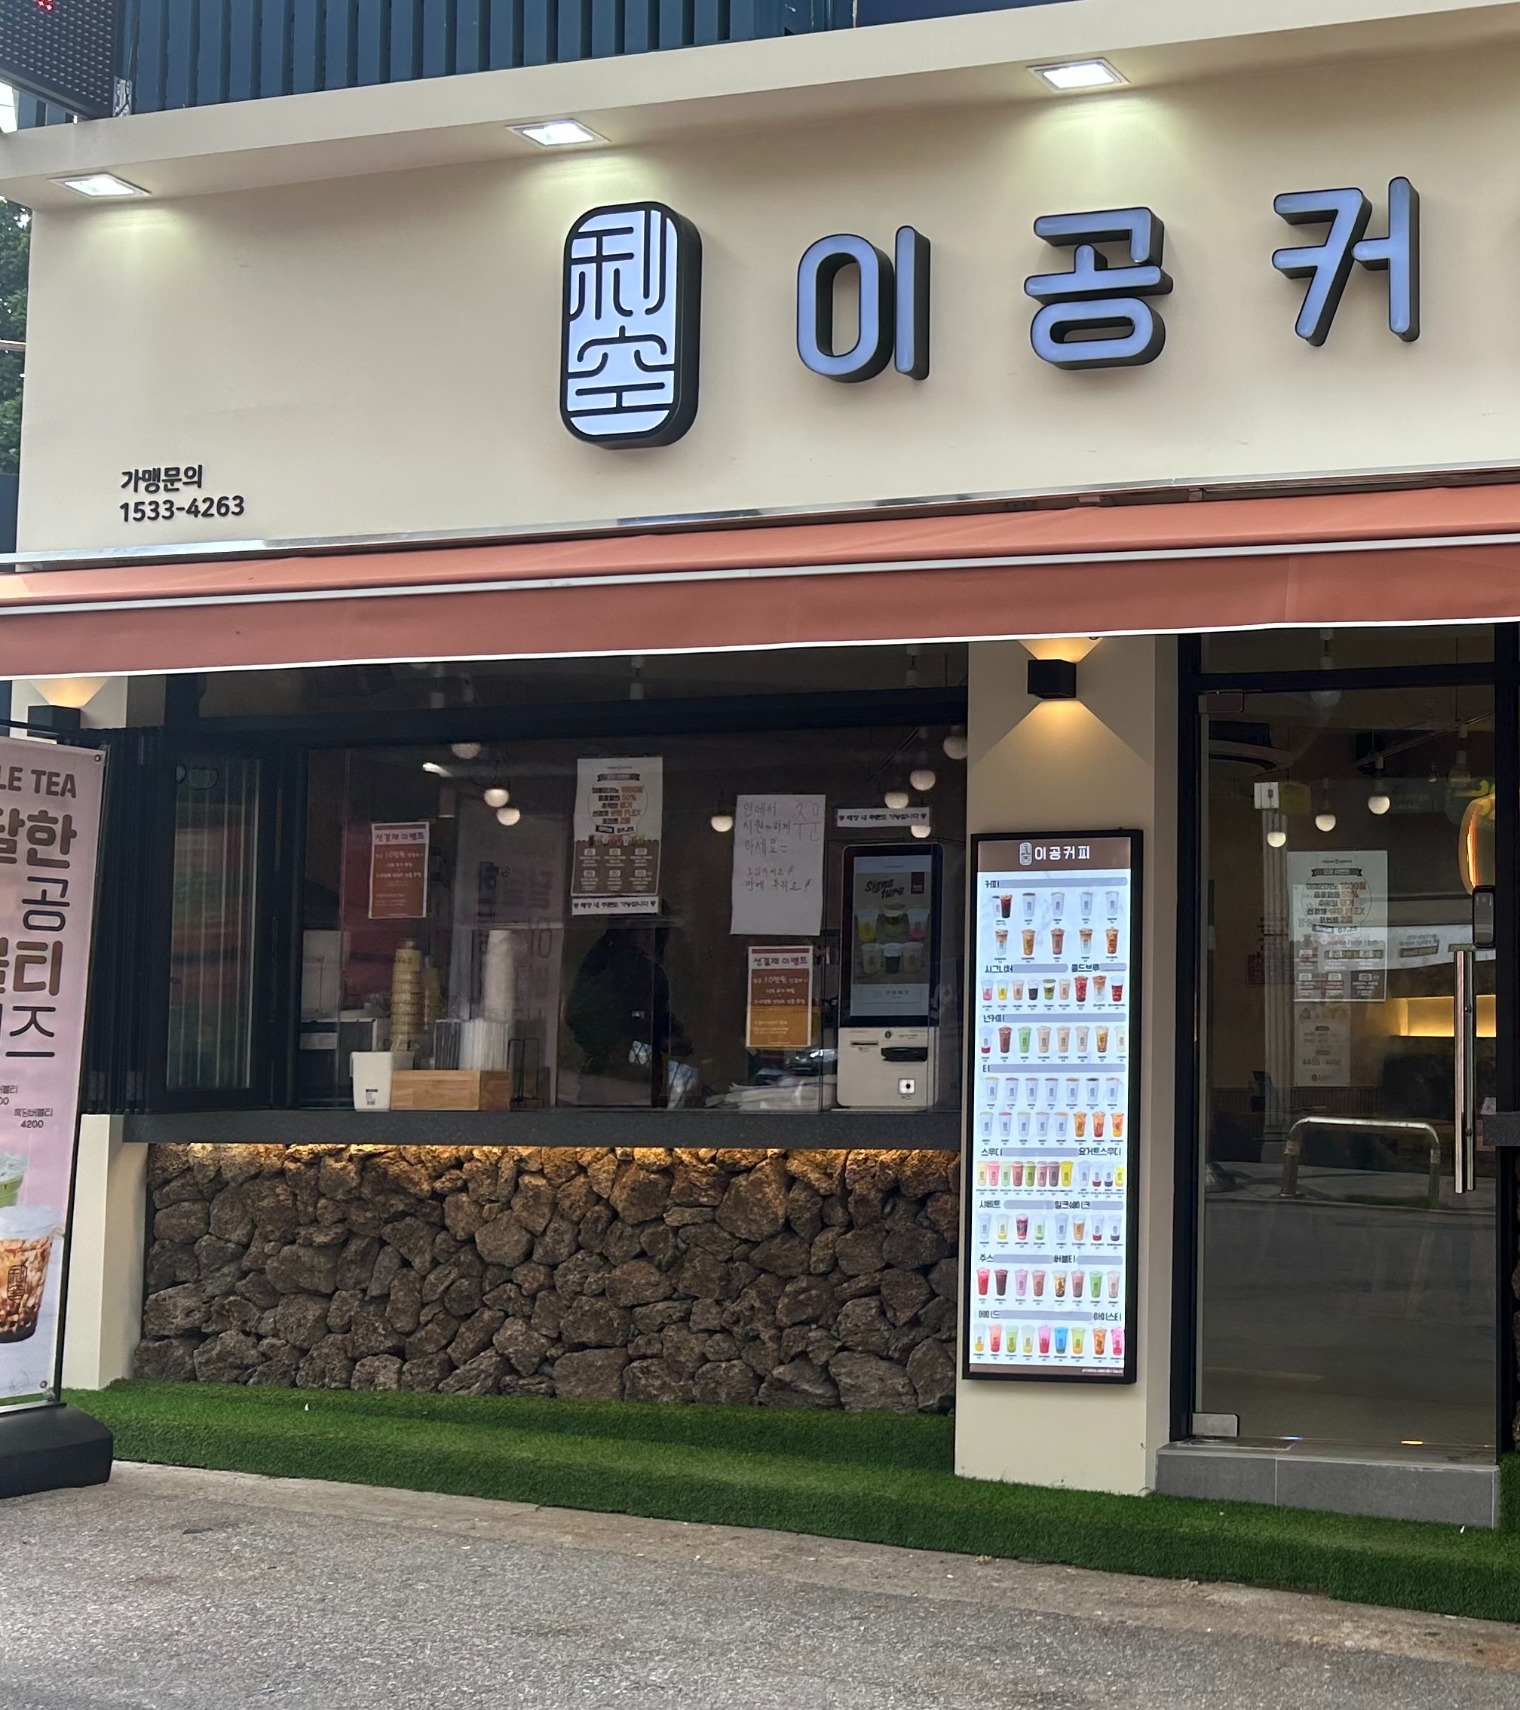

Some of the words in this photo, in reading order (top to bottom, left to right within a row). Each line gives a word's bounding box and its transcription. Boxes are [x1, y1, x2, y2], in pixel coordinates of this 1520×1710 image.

[120, 464, 204, 493] 가맹문의
[119, 495, 246, 523] 1533-4263
[30, 769, 77, 799] TEA
[1034, 844, 1090, 860] 이공커피
[20, 1119, 44, 1129] 4200
